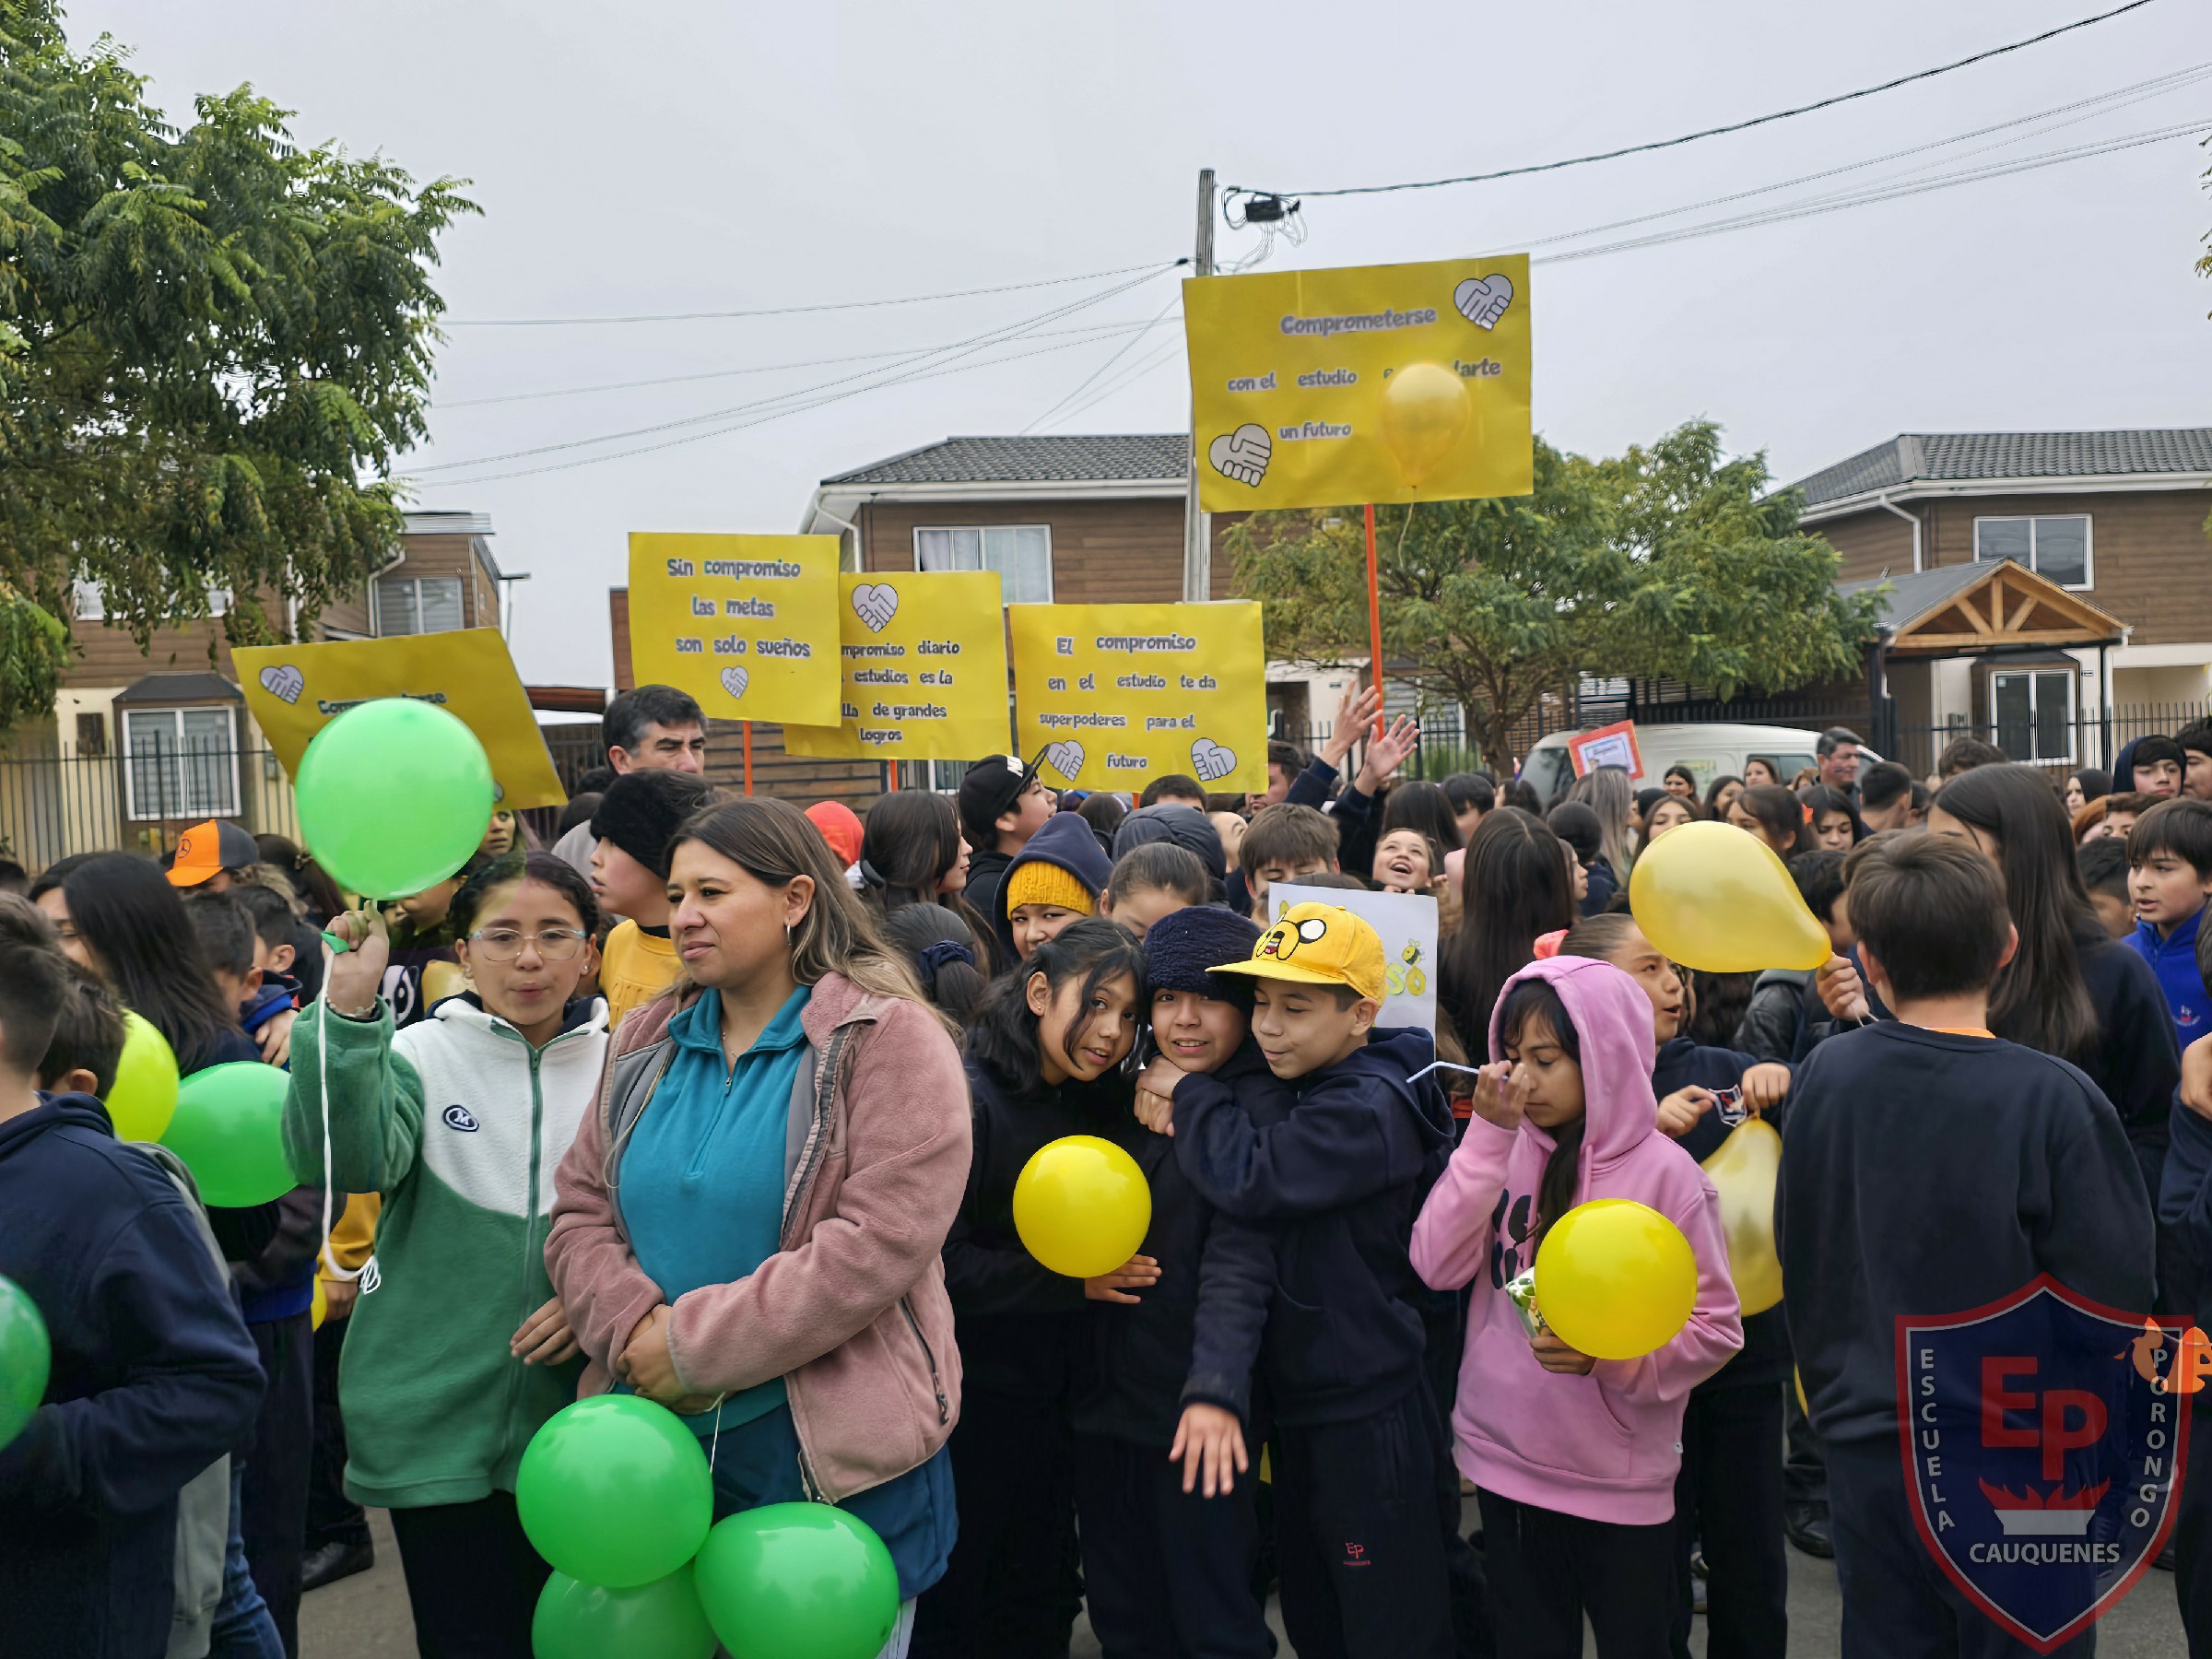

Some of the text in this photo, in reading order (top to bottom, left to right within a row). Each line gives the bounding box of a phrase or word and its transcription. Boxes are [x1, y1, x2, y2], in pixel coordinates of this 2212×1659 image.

[1281, 308, 1436, 335] Comprometerse
[1228, 358, 1500, 391] con el estudio larte
[1279, 421, 1351, 439] un futuro
[667, 559, 800, 580] Sin compromiso
[692, 596, 773, 617] las metas
[677, 635, 809, 657] son solo sueños
[841, 641, 959, 660] mpromiso diario
[1056, 633, 1195, 654] El compromiso
[855, 669, 909, 684] estudios
[920, 673, 935, 683] es
[939, 670, 952, 684] la
[1049, 674, 1217, 689] en el estudio te da
[873, 702, 889, 715] de
[893, 703, 947, 720] grandes
[1040, 712, 1195, 730] superpoderes para el
[860, 728, 901, 744] logros
[1108, 755, 1147, 769] futuro
